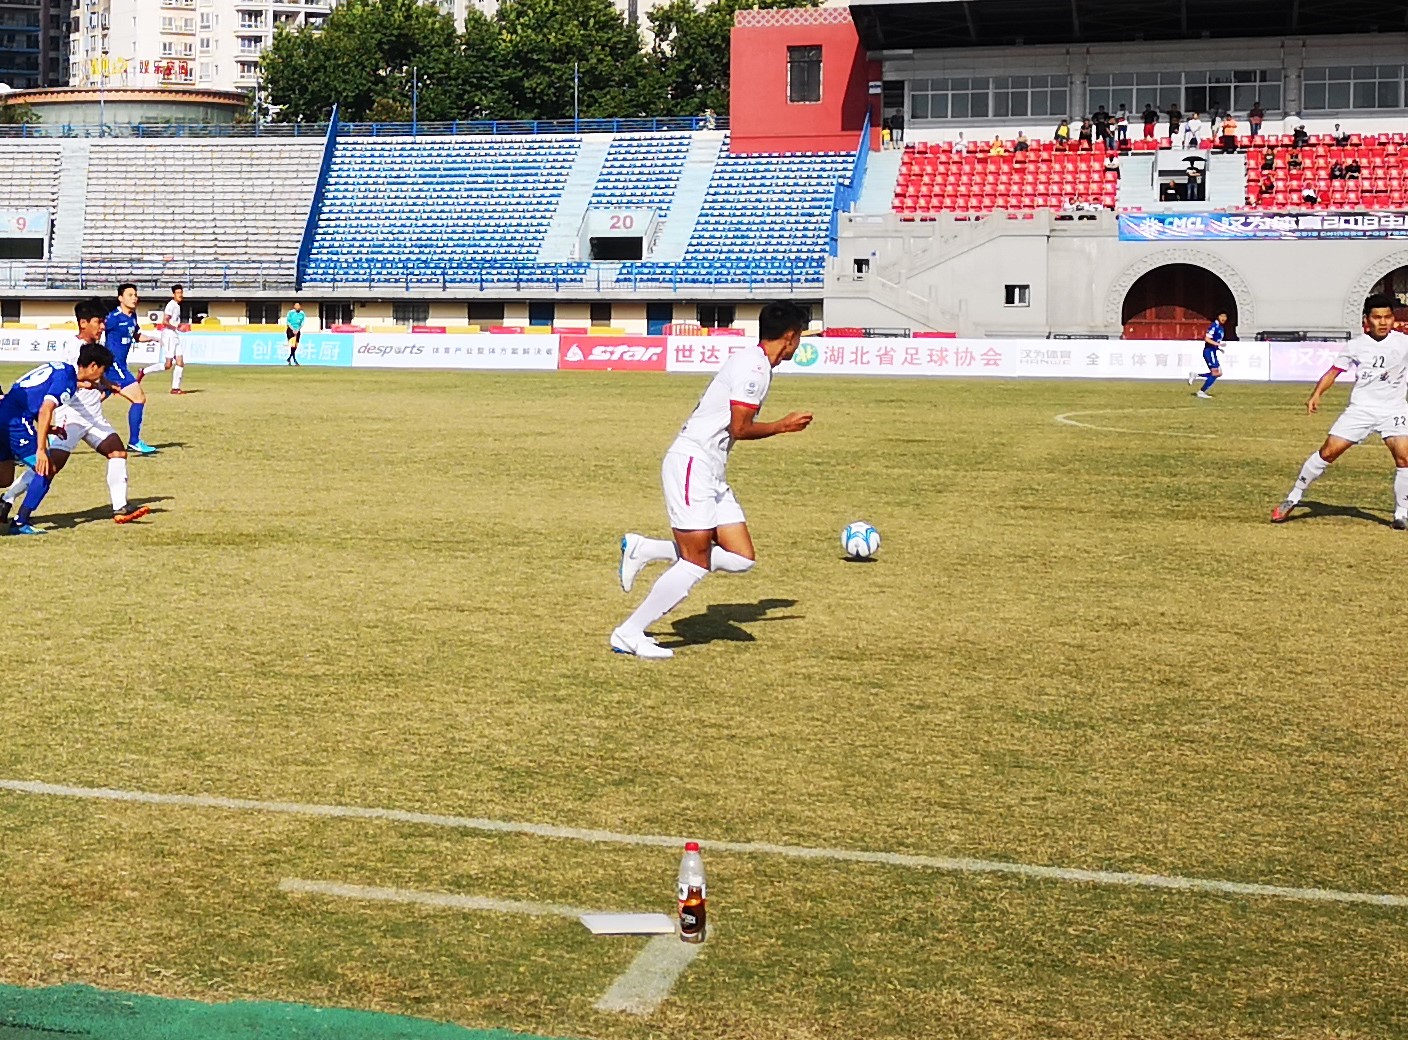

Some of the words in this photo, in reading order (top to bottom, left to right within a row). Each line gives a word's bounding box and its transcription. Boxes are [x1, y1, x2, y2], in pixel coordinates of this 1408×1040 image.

[15, 216, 27, 231] 9
[609, 215, 634, 230] 20
[357, 342, 425, 357] desports
[823, 346, 1003, 367] 湖北省足球协会
[1372, 355, 1385, 368] 22
